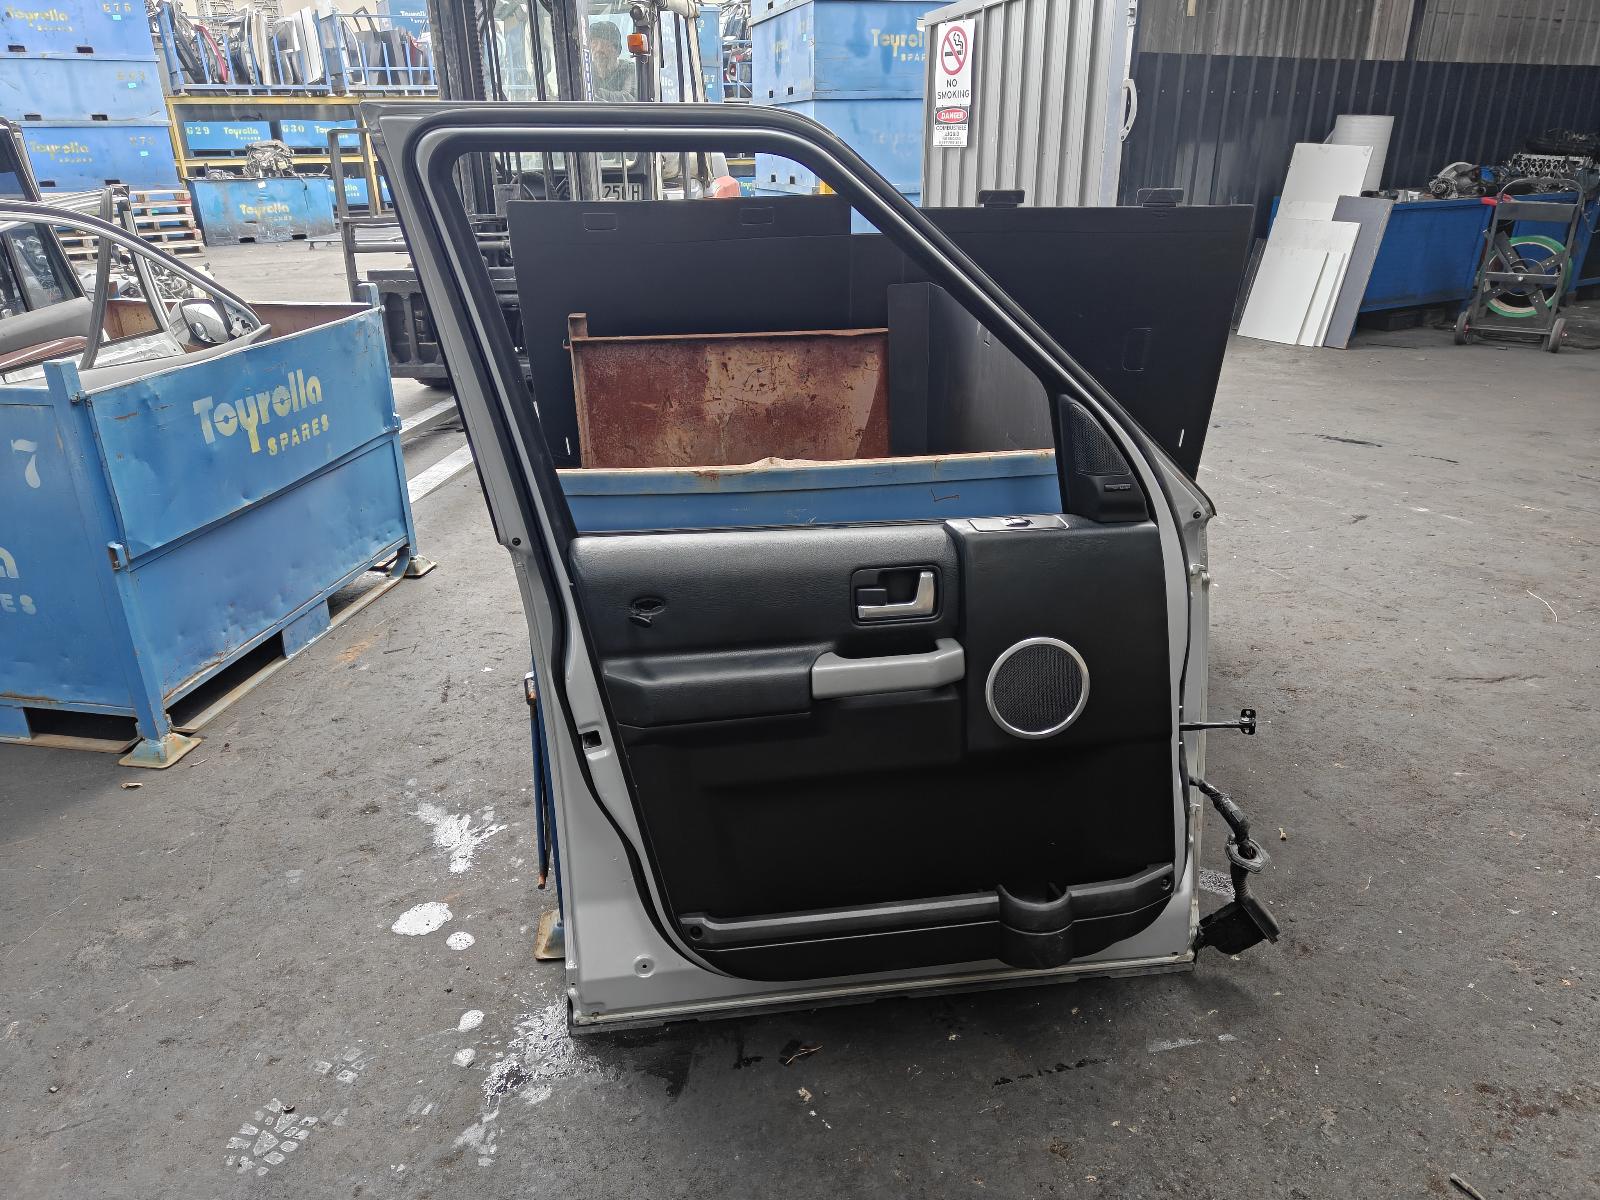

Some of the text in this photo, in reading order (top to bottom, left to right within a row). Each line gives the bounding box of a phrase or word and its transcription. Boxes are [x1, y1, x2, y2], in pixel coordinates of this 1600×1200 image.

[871, 29, 924, 57] Toyrol
[946, 78, 958, 88] NO
[937, 89, 970, 100] SMOKING
[941, 111, 964, 120] DANGER
[223, 126, 259, 139] Toyrolla
[192, 368, 323, 454] Toyrolla
[266, 413, 330, 456] SPARES
[10, 438, 41, 489] 7
